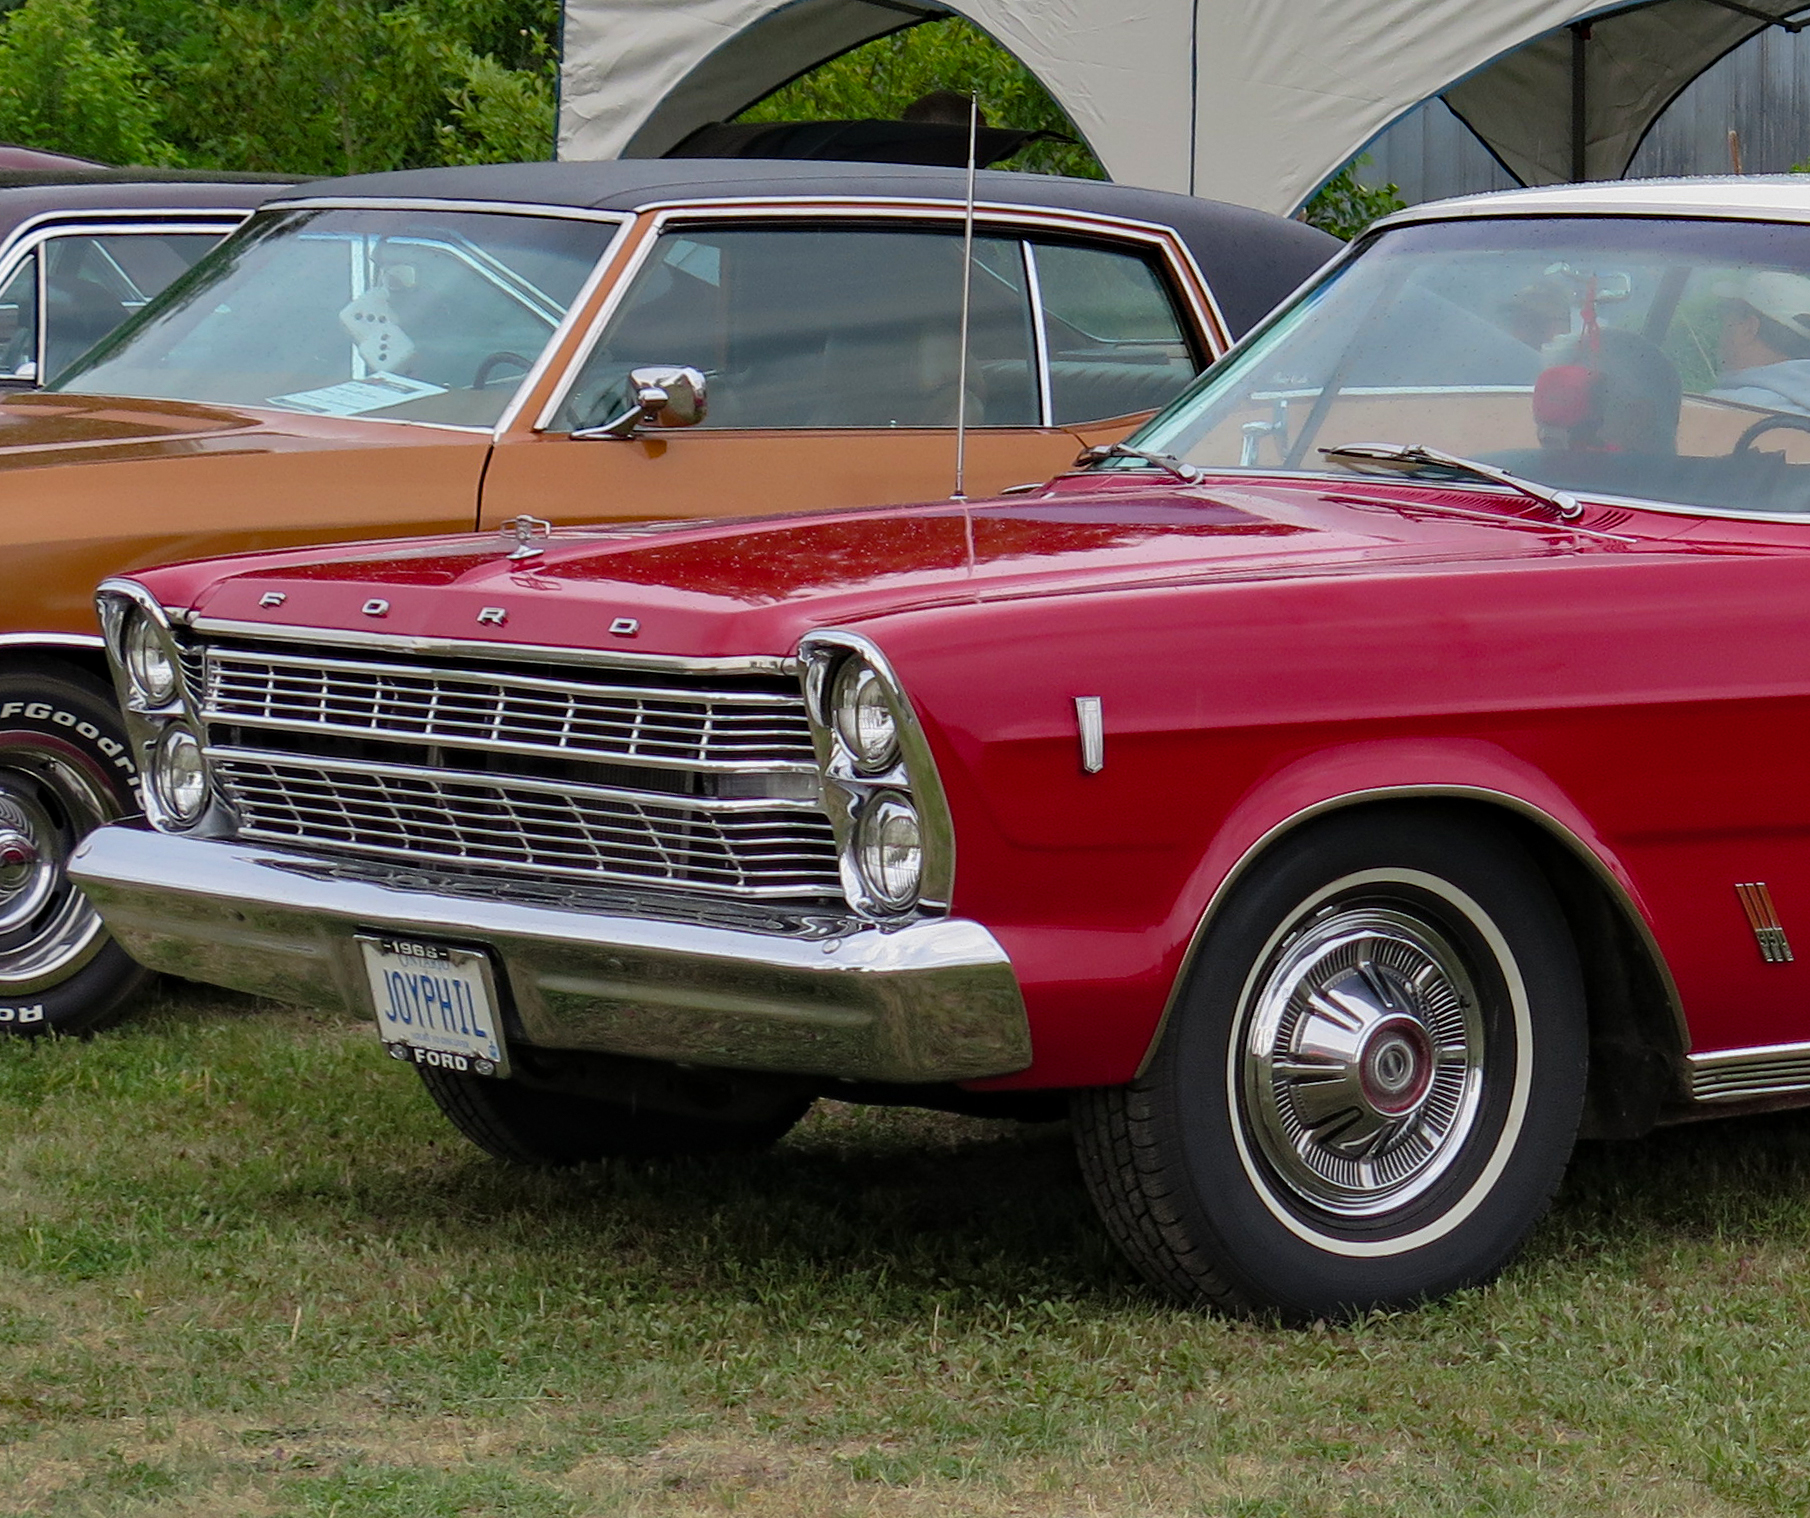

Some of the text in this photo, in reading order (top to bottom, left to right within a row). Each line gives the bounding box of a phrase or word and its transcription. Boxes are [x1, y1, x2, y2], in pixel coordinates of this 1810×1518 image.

[258, 592, 641, 636] FORD
[0, 702, 147, 811] FGoodric
[384, 969, 487, 1037] JOYPHIL
[414, 1048, 468, 1071] FORD
